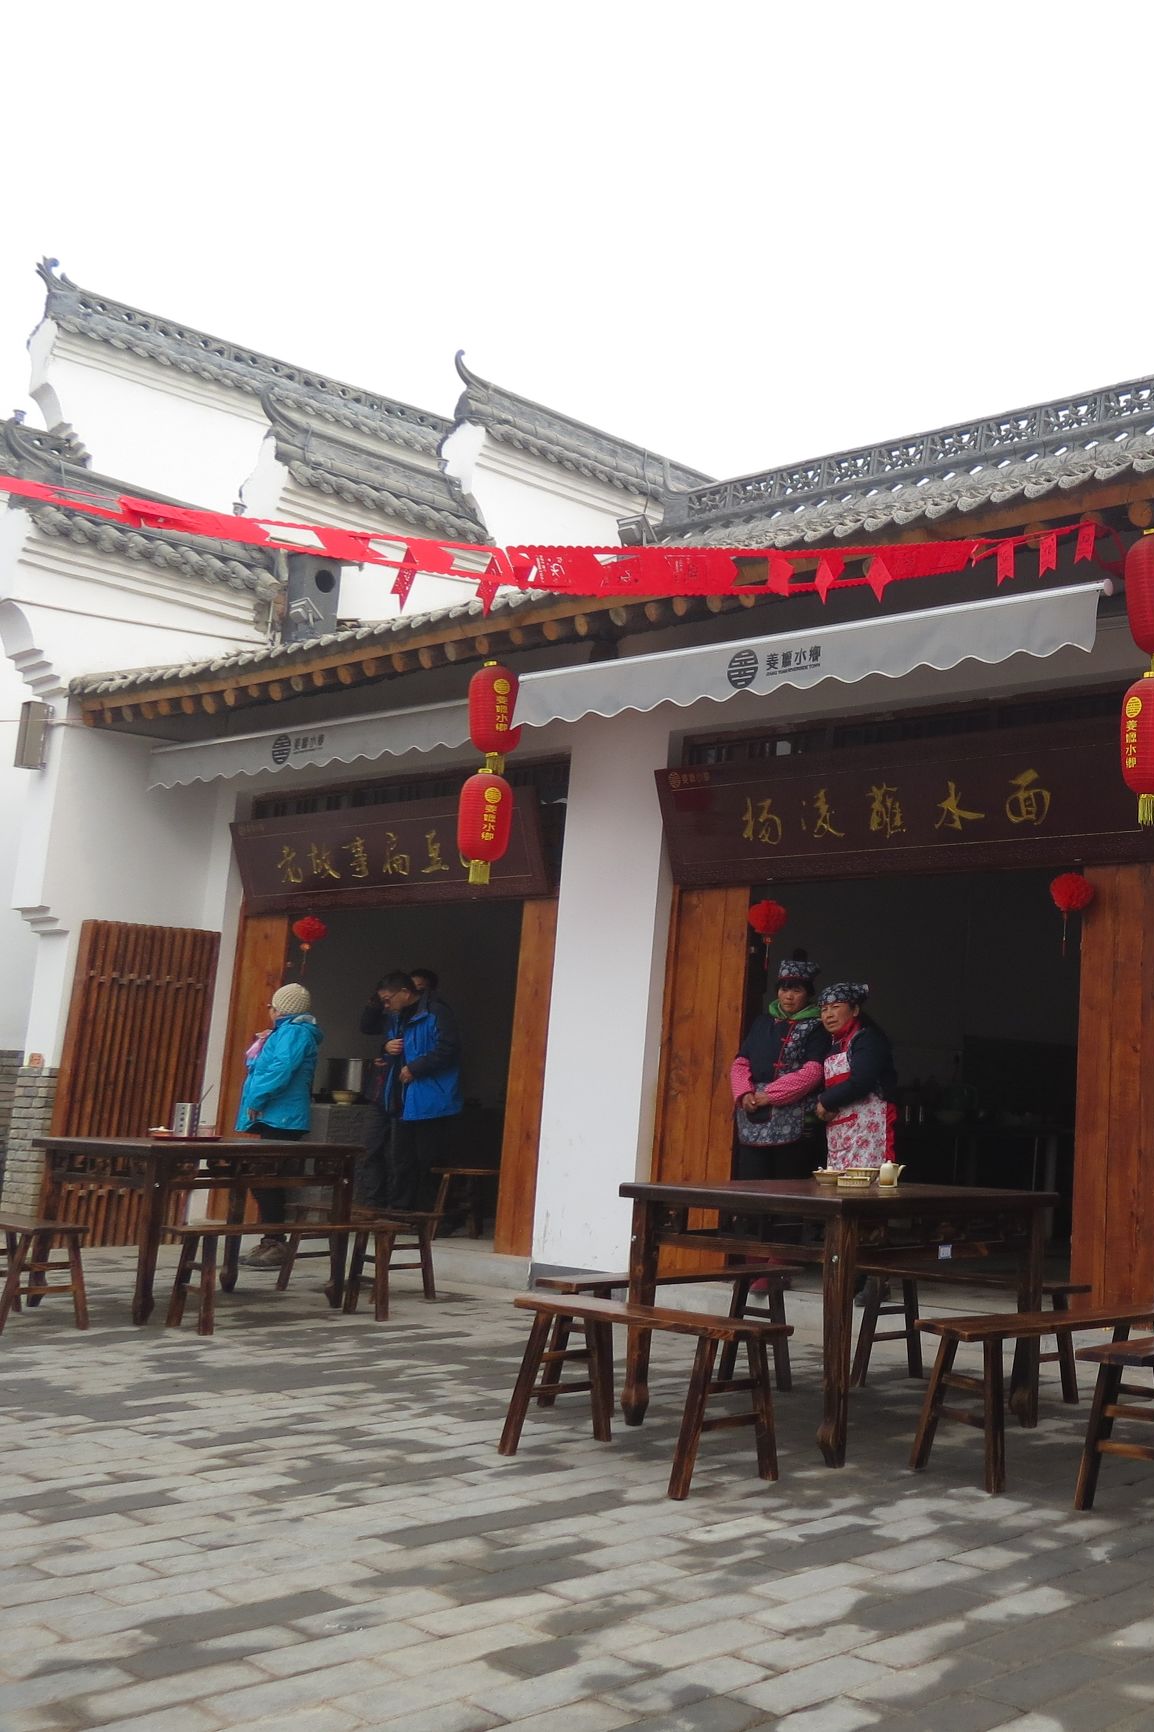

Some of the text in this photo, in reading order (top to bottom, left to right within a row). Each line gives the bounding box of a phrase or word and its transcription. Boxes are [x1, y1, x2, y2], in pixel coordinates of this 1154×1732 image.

[277, 829, 470, 884] 老故事扁豆
